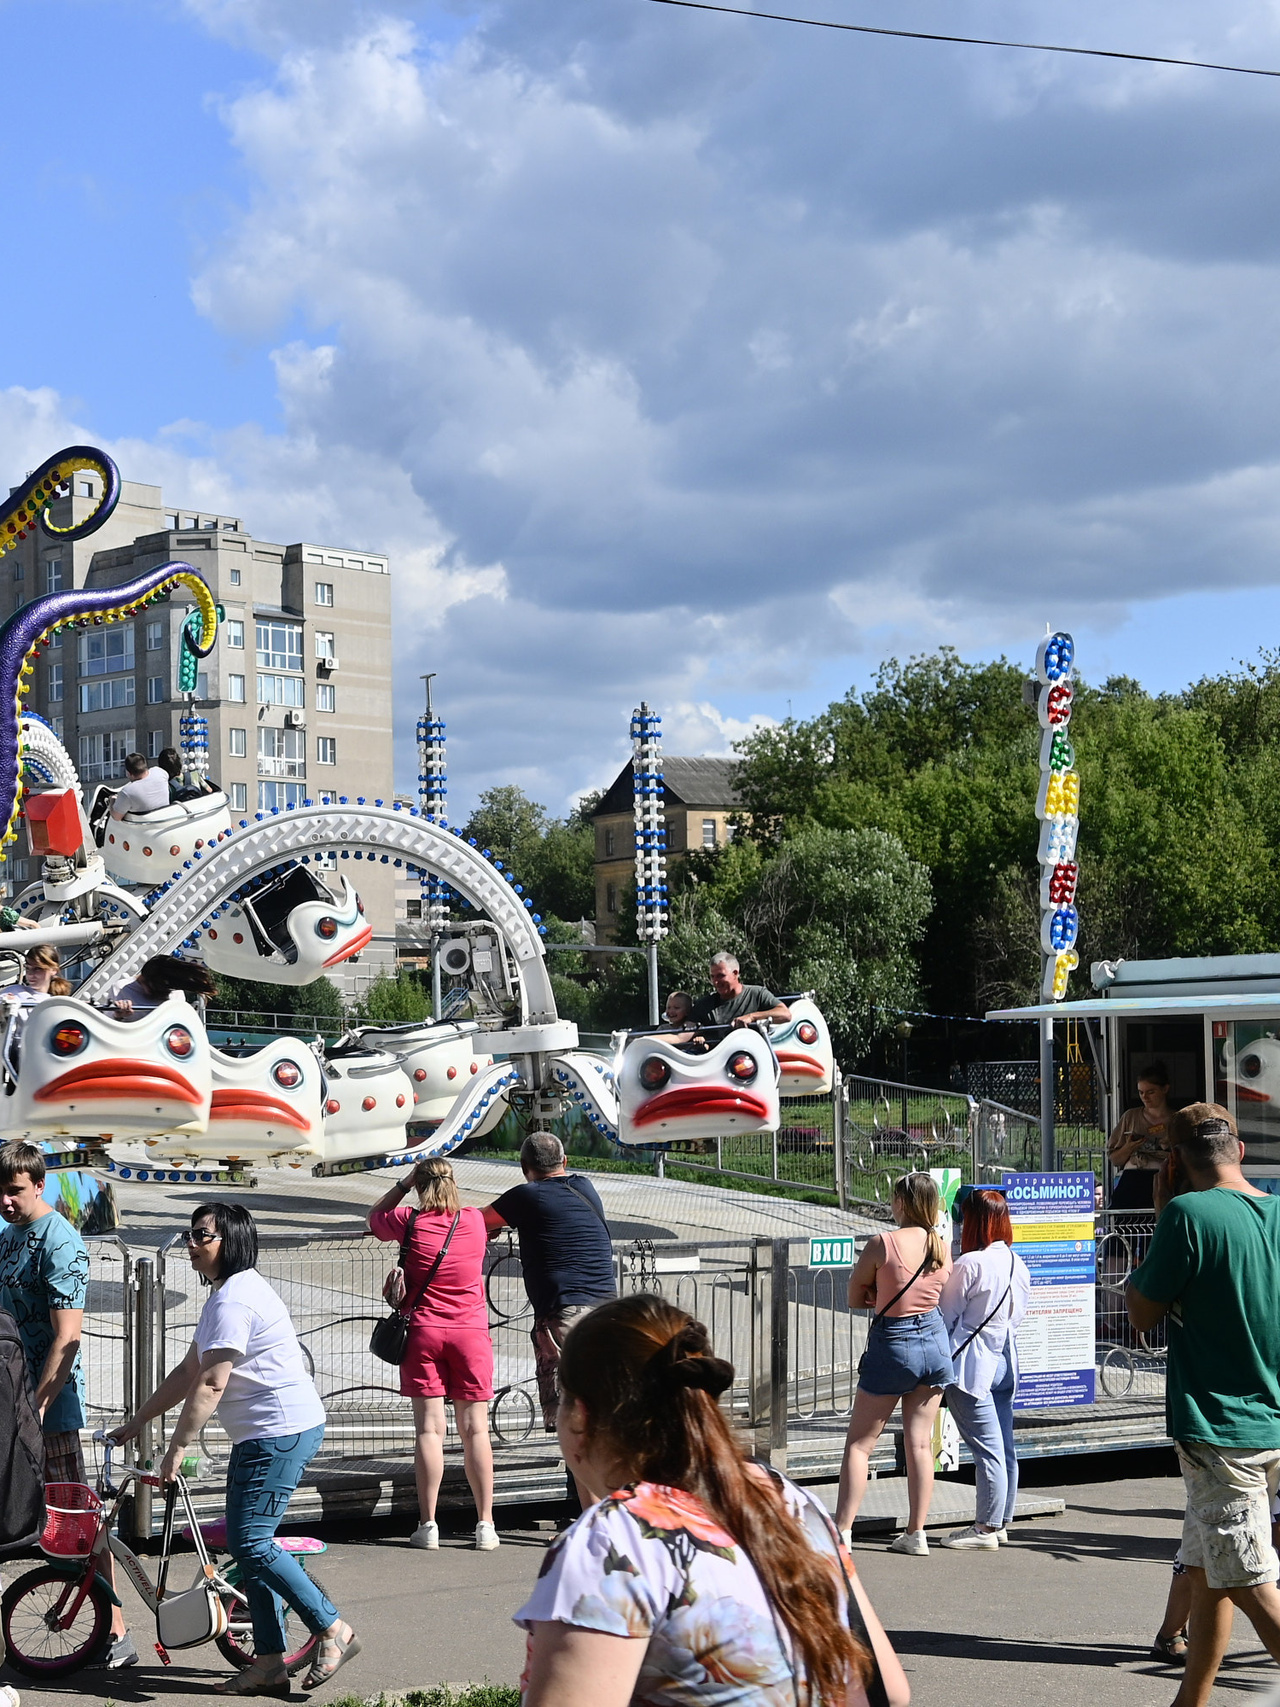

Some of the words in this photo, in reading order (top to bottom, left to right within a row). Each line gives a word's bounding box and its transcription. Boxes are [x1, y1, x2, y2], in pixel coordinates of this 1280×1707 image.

[1040, 631, 1079, 999] ОСЬМИНОГ
[1007, 1177, 1089, 1185] аттракцион
[1006, 1185, 1090, 1199] «ОСЬМИНОГ»
[813, 1242, 852, 1263] ВХОД
[124, 1554, 154, 1597] ACTIWELL
